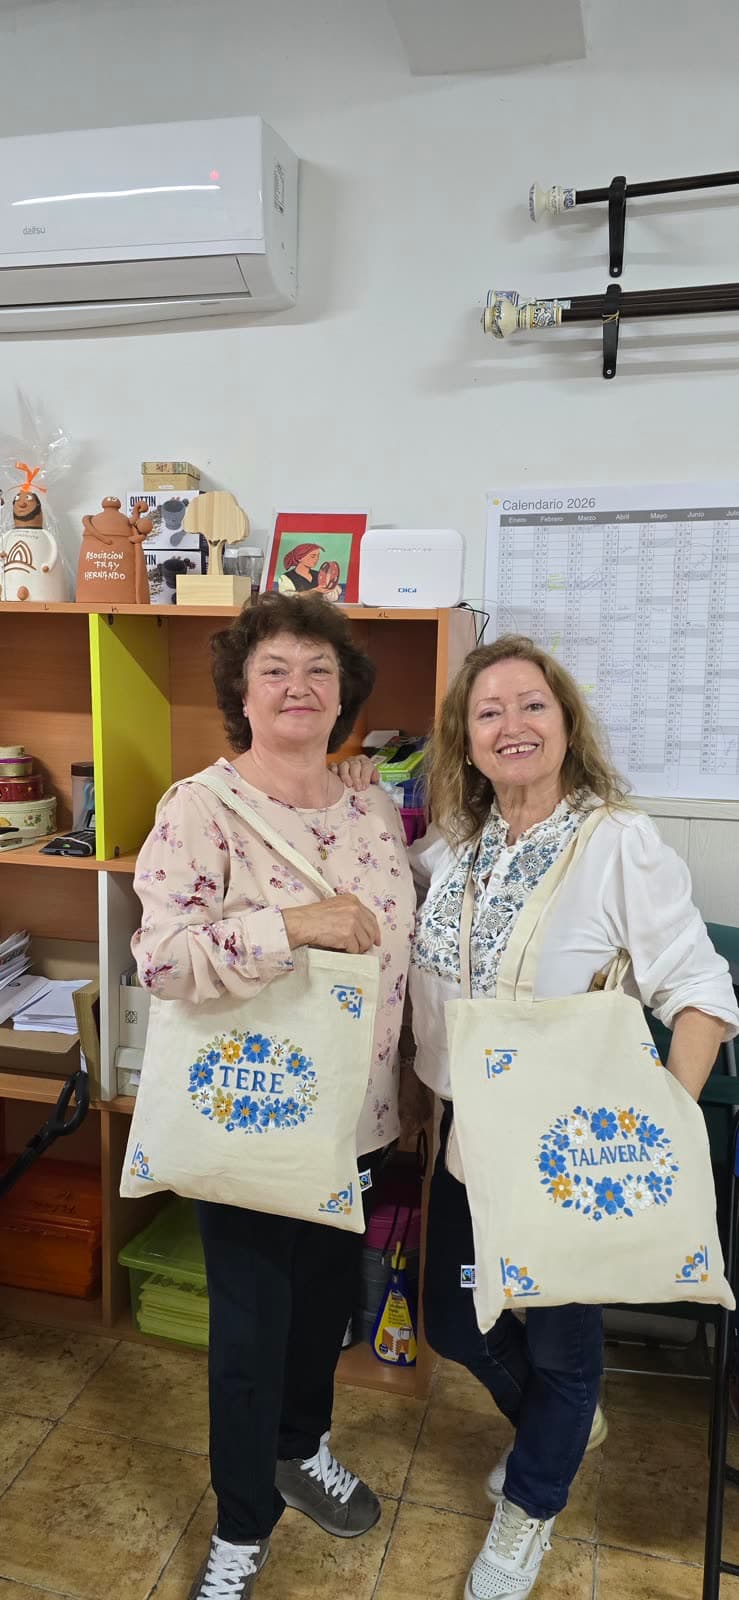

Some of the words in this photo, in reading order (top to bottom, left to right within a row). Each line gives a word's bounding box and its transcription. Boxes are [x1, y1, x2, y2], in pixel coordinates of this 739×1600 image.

[502, 499, 564, 511] Calendario
[566, 498, 596, 509] 2026
[540, 515, 564, 523] Febrero
[615, 512, 630, 521] Abril
[650, 512, 668, 520] Mayo
[84, 570, 126, 581] HERNANDO
[219, 1065, 284, 1094] TERE
[568, 1144, 651, 1166] TALAVERA
